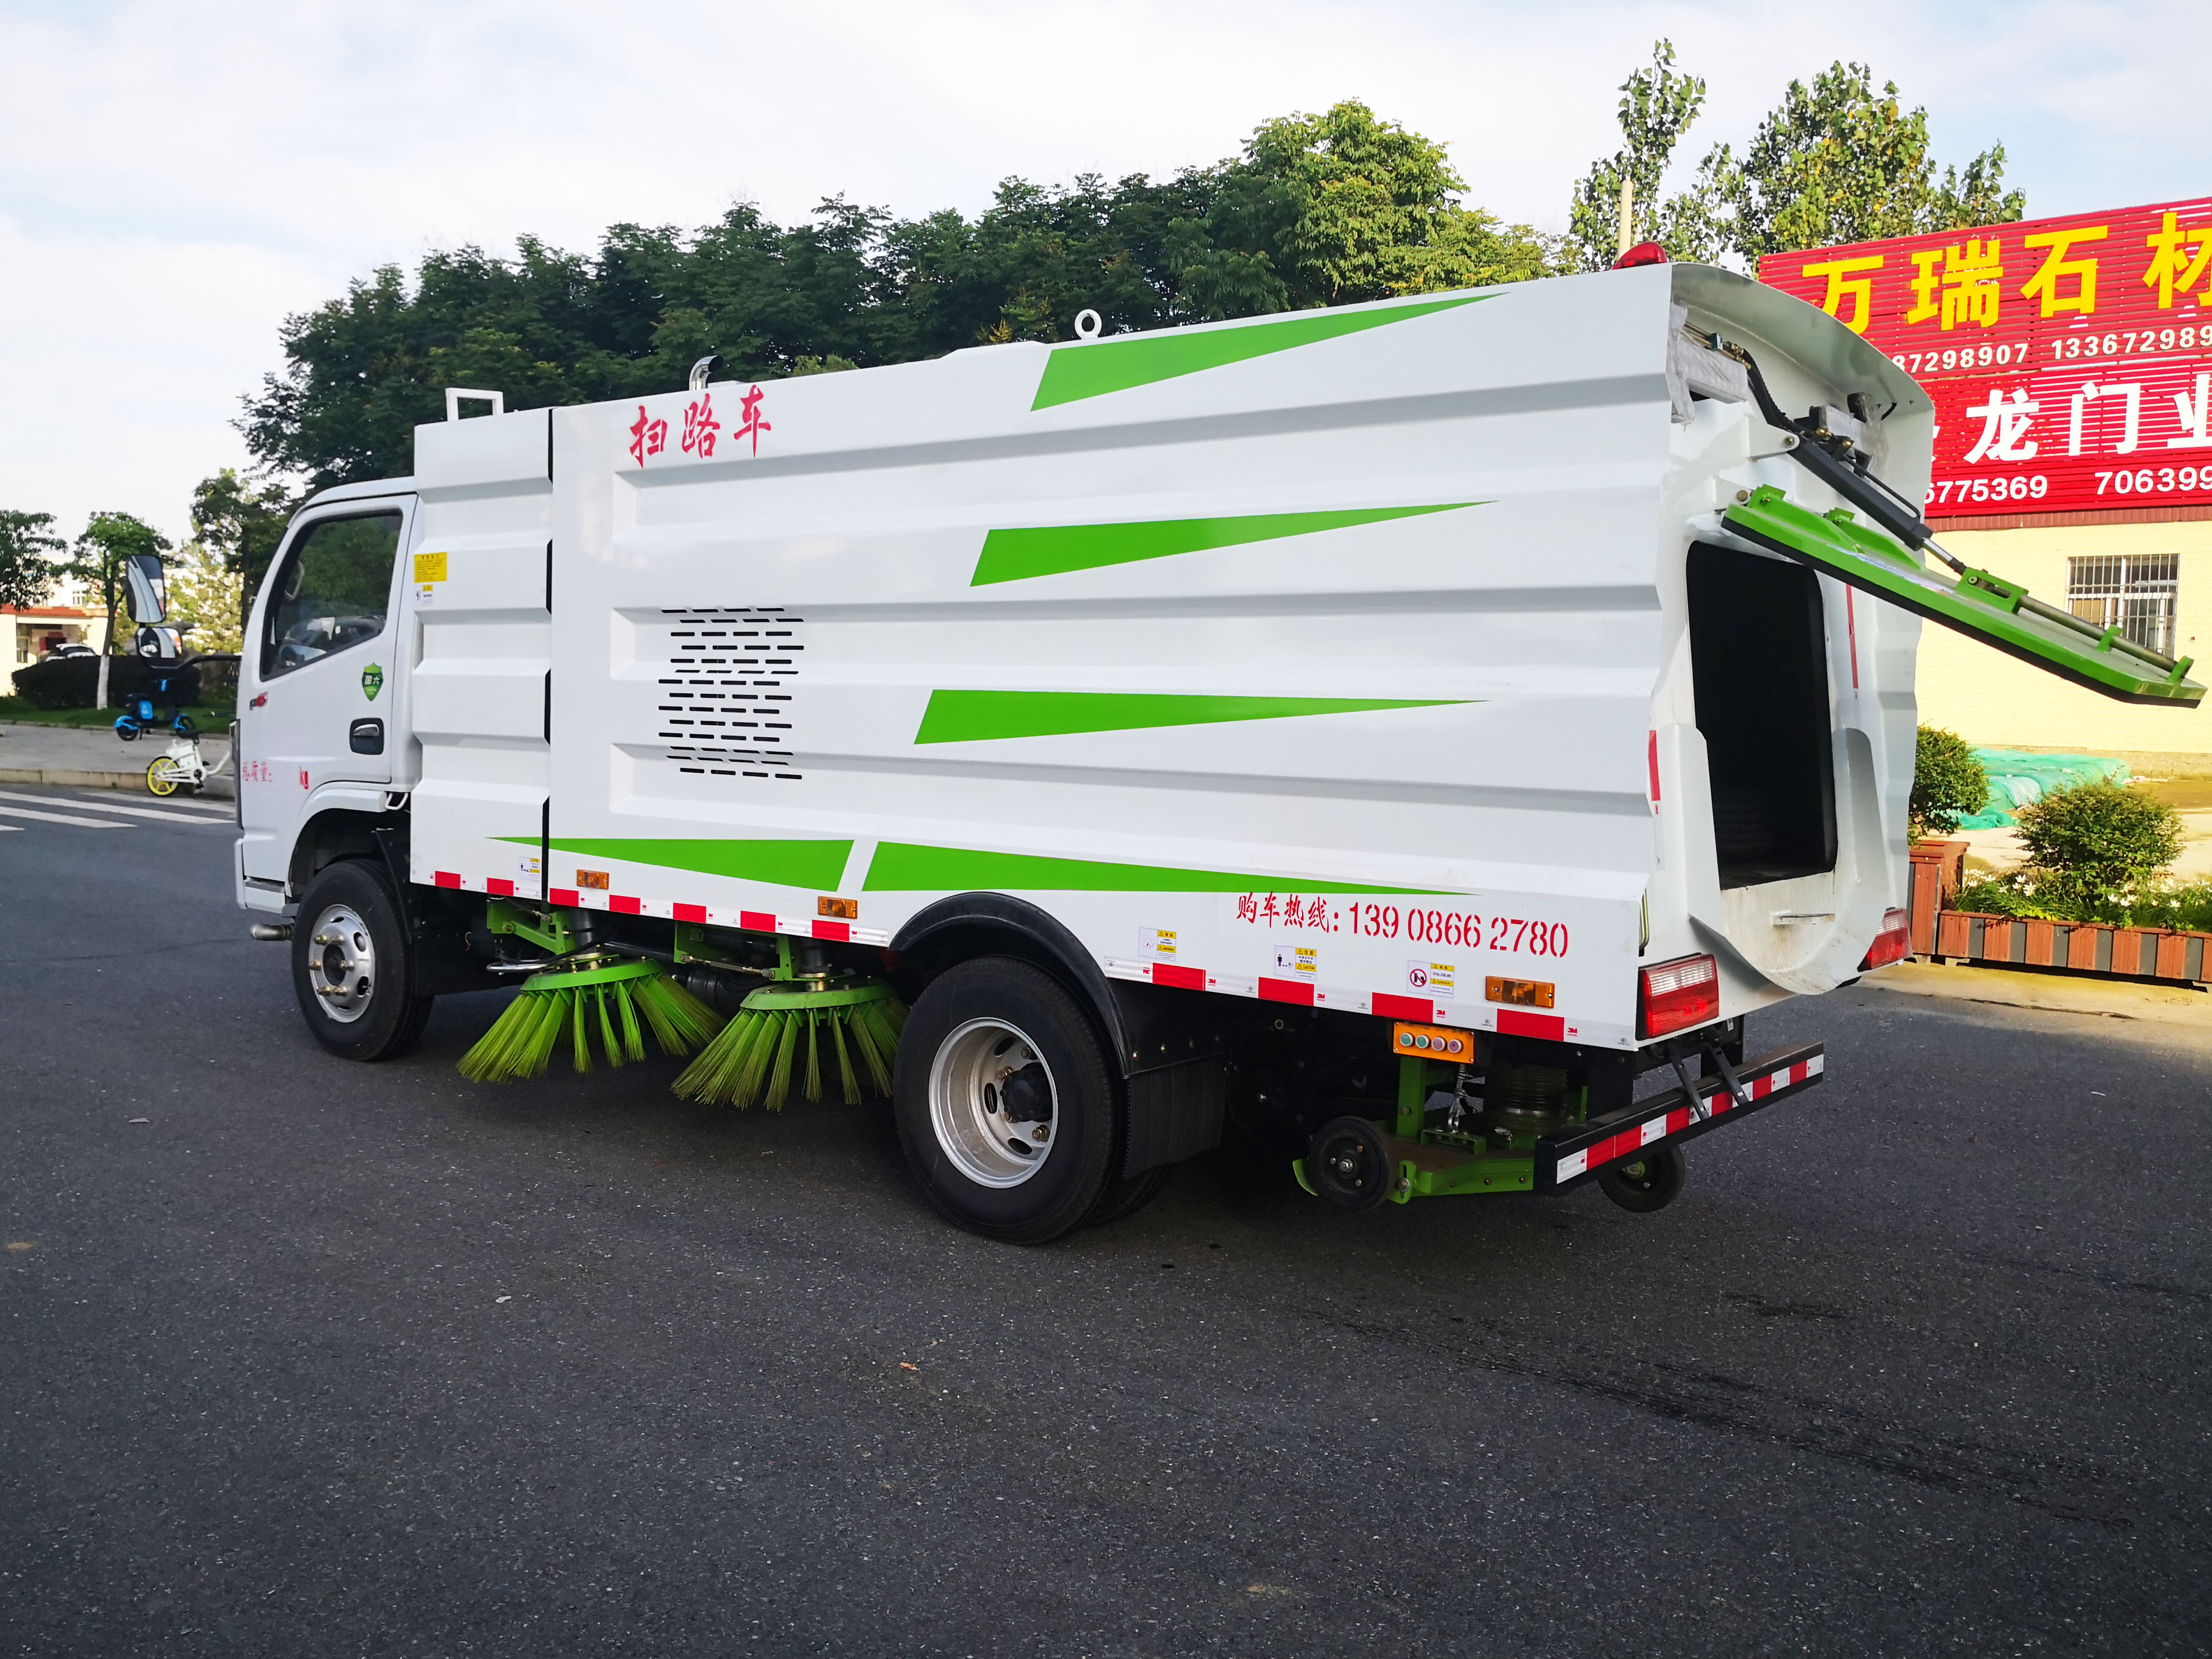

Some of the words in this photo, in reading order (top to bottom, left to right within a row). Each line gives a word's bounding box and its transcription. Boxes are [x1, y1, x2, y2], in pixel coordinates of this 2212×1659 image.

[1802, 212, 2212, 334] 万瑞石材
[2051, 325, 2212, 360] 133672989
[629, 384, 771, 468] 扫路车
[1933, 374, 2212, 464] 龙门业
[2094, 465, 2212, 495] 706399
[1349, 902, 1400, 938] 139
[1408, 908, 1481, 948] 0866
[1489, 916, 1568, 958] 2780
